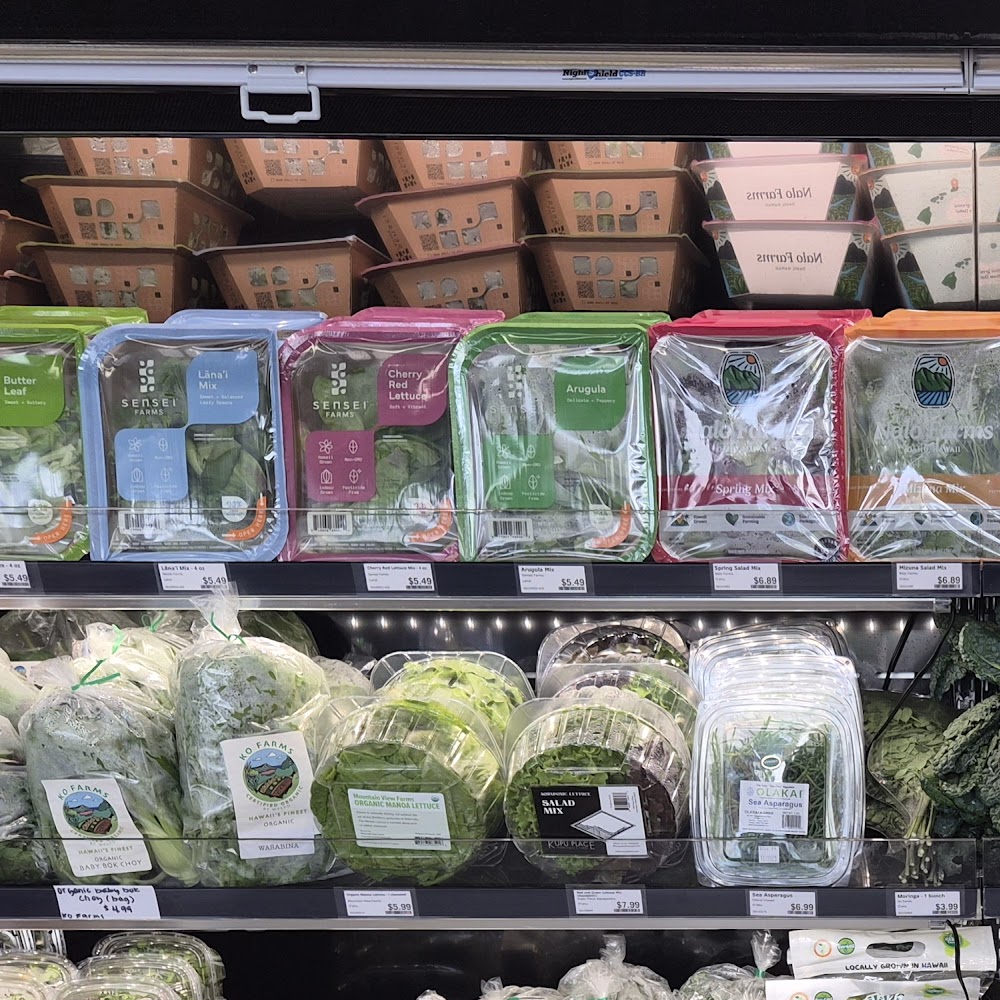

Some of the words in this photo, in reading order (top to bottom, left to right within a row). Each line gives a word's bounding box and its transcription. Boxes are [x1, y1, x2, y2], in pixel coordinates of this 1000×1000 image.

[388, 370, 422, 380] Cherry
[4, 376, 36, 385] Butter
[199, 381, 217, 390] Mix
[388, 381, 408, 389] Red
[4, 387, 27, 396] Leaf
[566, 384, 606, 395] Arugula
[389, 392, 428, 400] Lettuce
[122, 398, 176, 408] SENSEI
[312, 402, 367, 410] SENSEI
[716, 484, 752, 496] Spring
[4, 574, 28, 582] $5.49
[202, 577, 227, 585] $5.49
[408, 577, 432, 586] $5.49
[561, 578, 585, 586] $5.49
[753, 576, 777, 585] $6.89
[937, 576, 961, 584] $6.89
[240, 747, 252, 761] KO
[256, 740, 294, 755] FARMS
[58, 789, 69, 800] KO
[71, 784, 110, 798] FARMS
[756, 788, 803, 799] OLAKAI
[411, 802, 440, 810] LETTUCE
[542, 799, 575, 807] SALAD
[764, 799, 803, 810] Asparagus
[284, 809, 308, 817] FINEST
[543, 807, 564, 815] MIX
[264, 819, 294, 827] ORGANIC
[258, 842, 300, 852] WASABINA
[79, 863, 99, 871] BABY
[120, 859, 142, 867] CHOY
[58, 887, 91, 896] Organic
[106, 896, 135, 904] (bag)
[616, 901, 640, 909] $7.99
[790, 903, 814, 911] $6.99
[935, 903, 958, 911] $3.99
